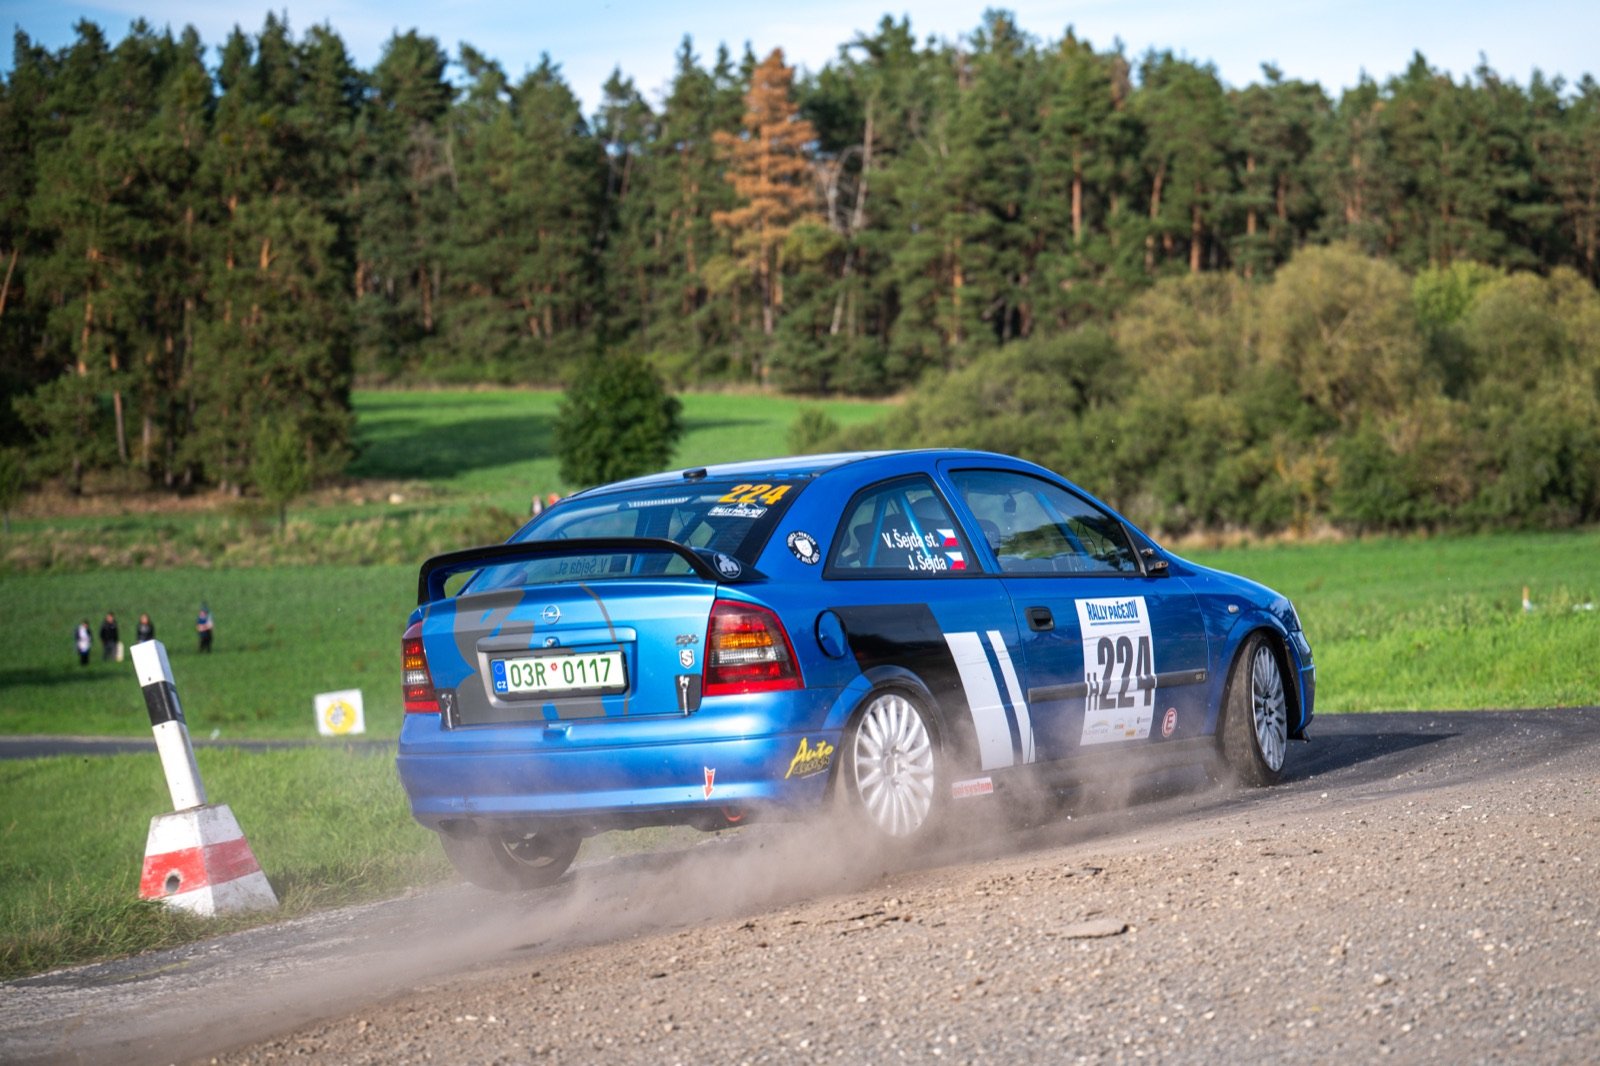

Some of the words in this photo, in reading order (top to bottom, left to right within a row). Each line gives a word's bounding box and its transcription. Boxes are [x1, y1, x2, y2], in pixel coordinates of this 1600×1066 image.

[719, 484, 792, 505] 224
[882, 532, 895, 549] V.
[893, 528, 924, 551] Šejda
[924, 532, 939, 548] st.
[908, 555, 918, 571] J.
[917, 551, 947, 573] Šejda
[1086, 601, 1108, 621] RALLY
[1107, 599, 1139, 620] PAČEJOV
[496, 681, 507, 689] CZ
[510, 661, 547, 688] 03R
[562, 657, 611, 685] 0117
[1097, 635, 1151, 710] 224
[785, 737, 834, 779] Auto
